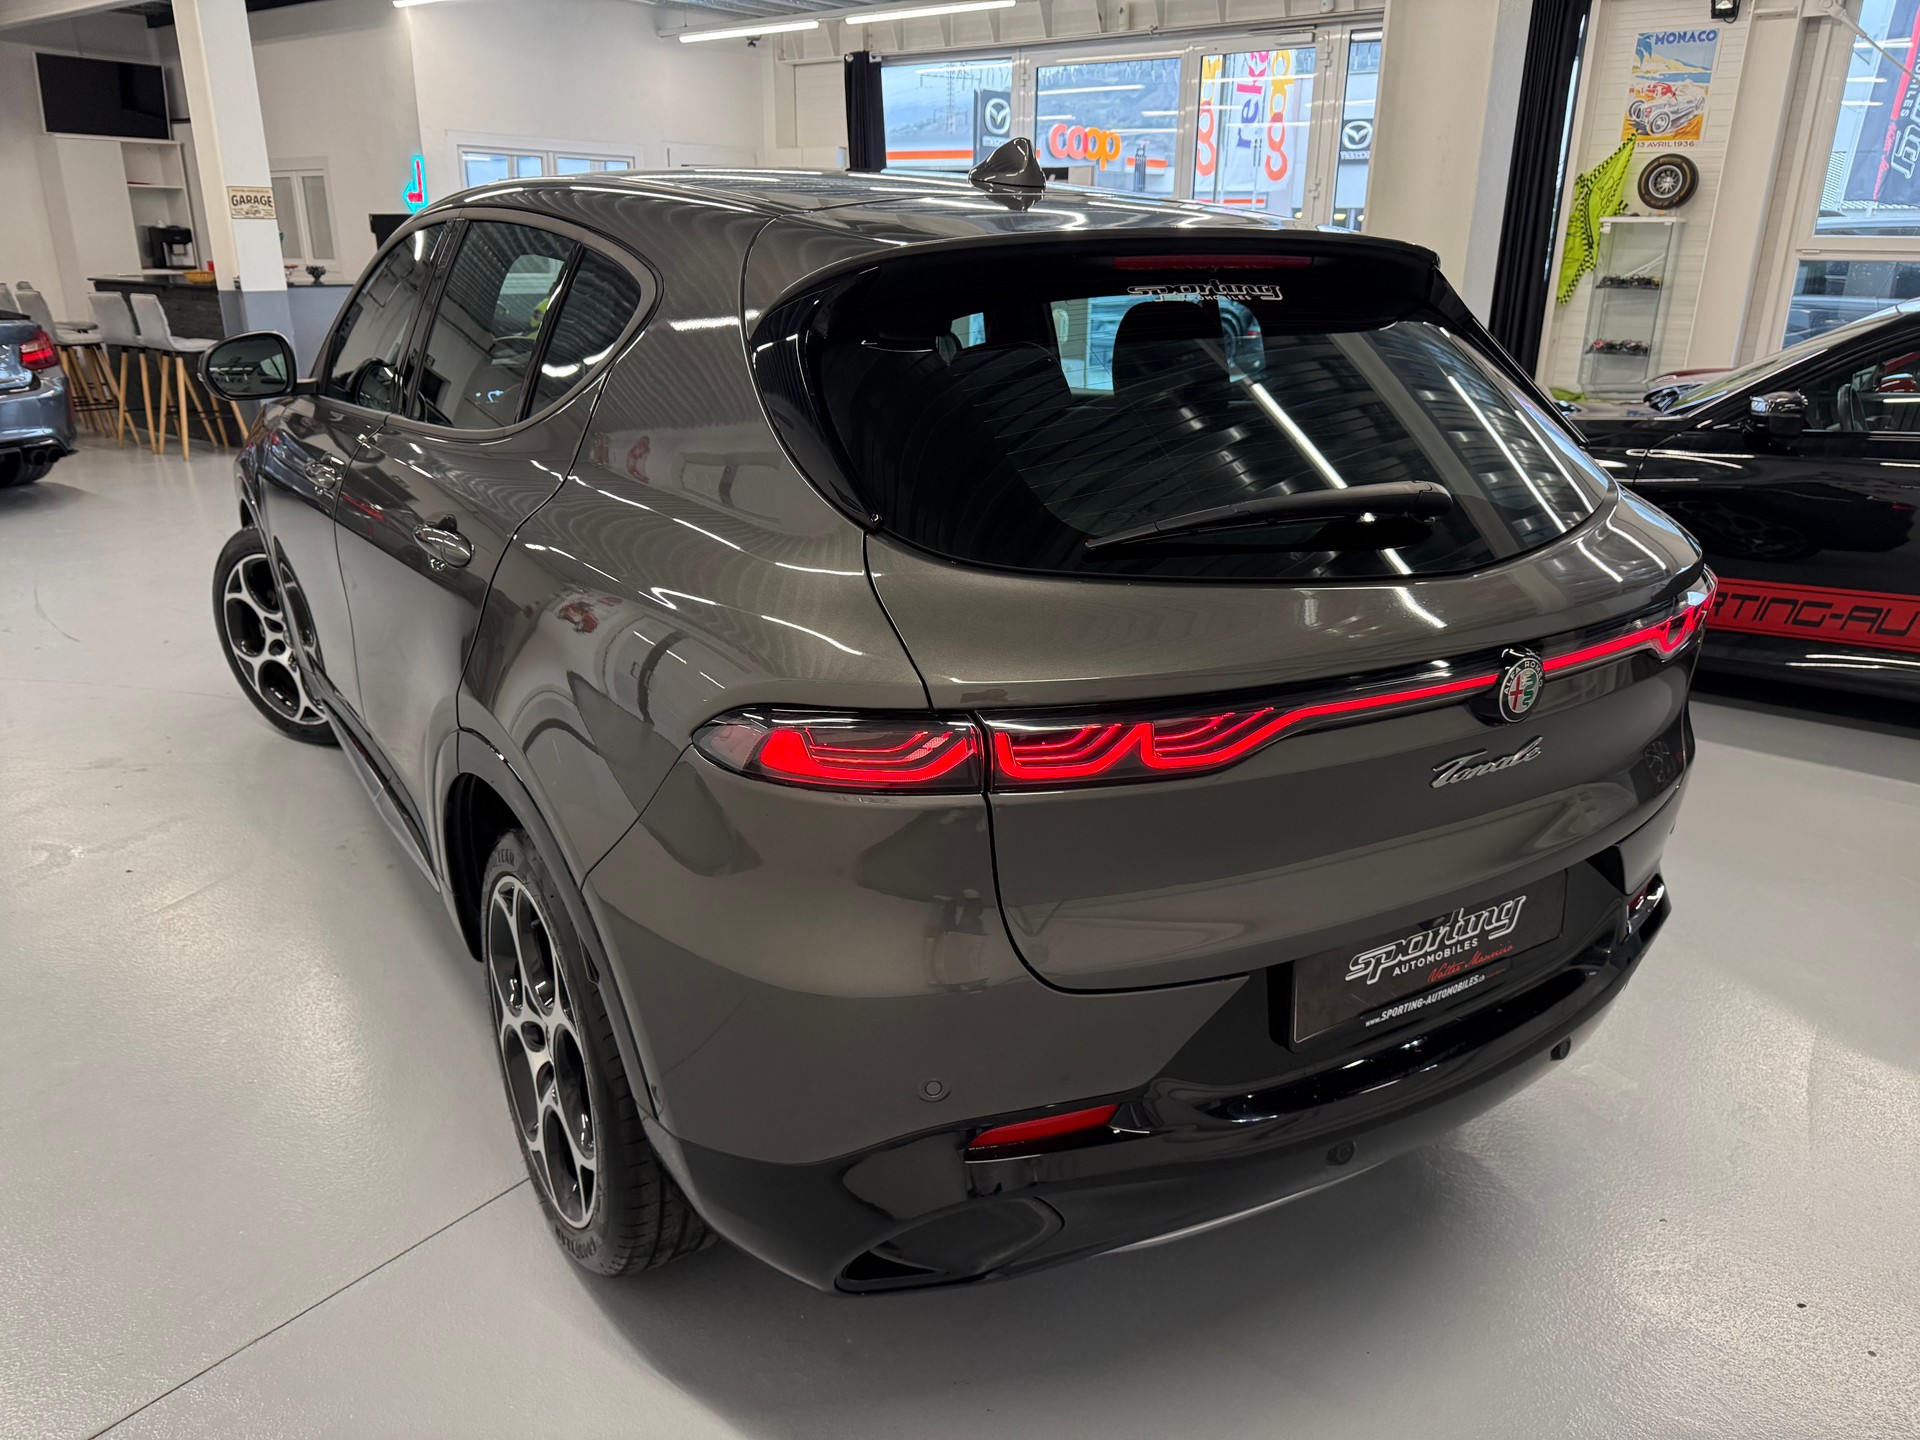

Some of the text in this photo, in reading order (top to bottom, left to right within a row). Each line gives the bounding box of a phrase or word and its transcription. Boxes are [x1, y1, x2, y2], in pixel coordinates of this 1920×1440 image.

[1655, 30, 1718, 45] MONACO
[1264, 50, 1295, 182] coop
[1049, 123, 1121, 171] coop
[231, 194, 273, 208] GARAGE
[1504, 661, 1543, 694] ALFA ROMEO
[1430, 736, 1543, 788] Tonale
[1345, 895, 1527, 985] sporting
[1393, 938, 1479, 977] AUTOMOBILES
[1365, 974, 1486, 1028] www.SPORTING-AUTOMOBILES.ch
